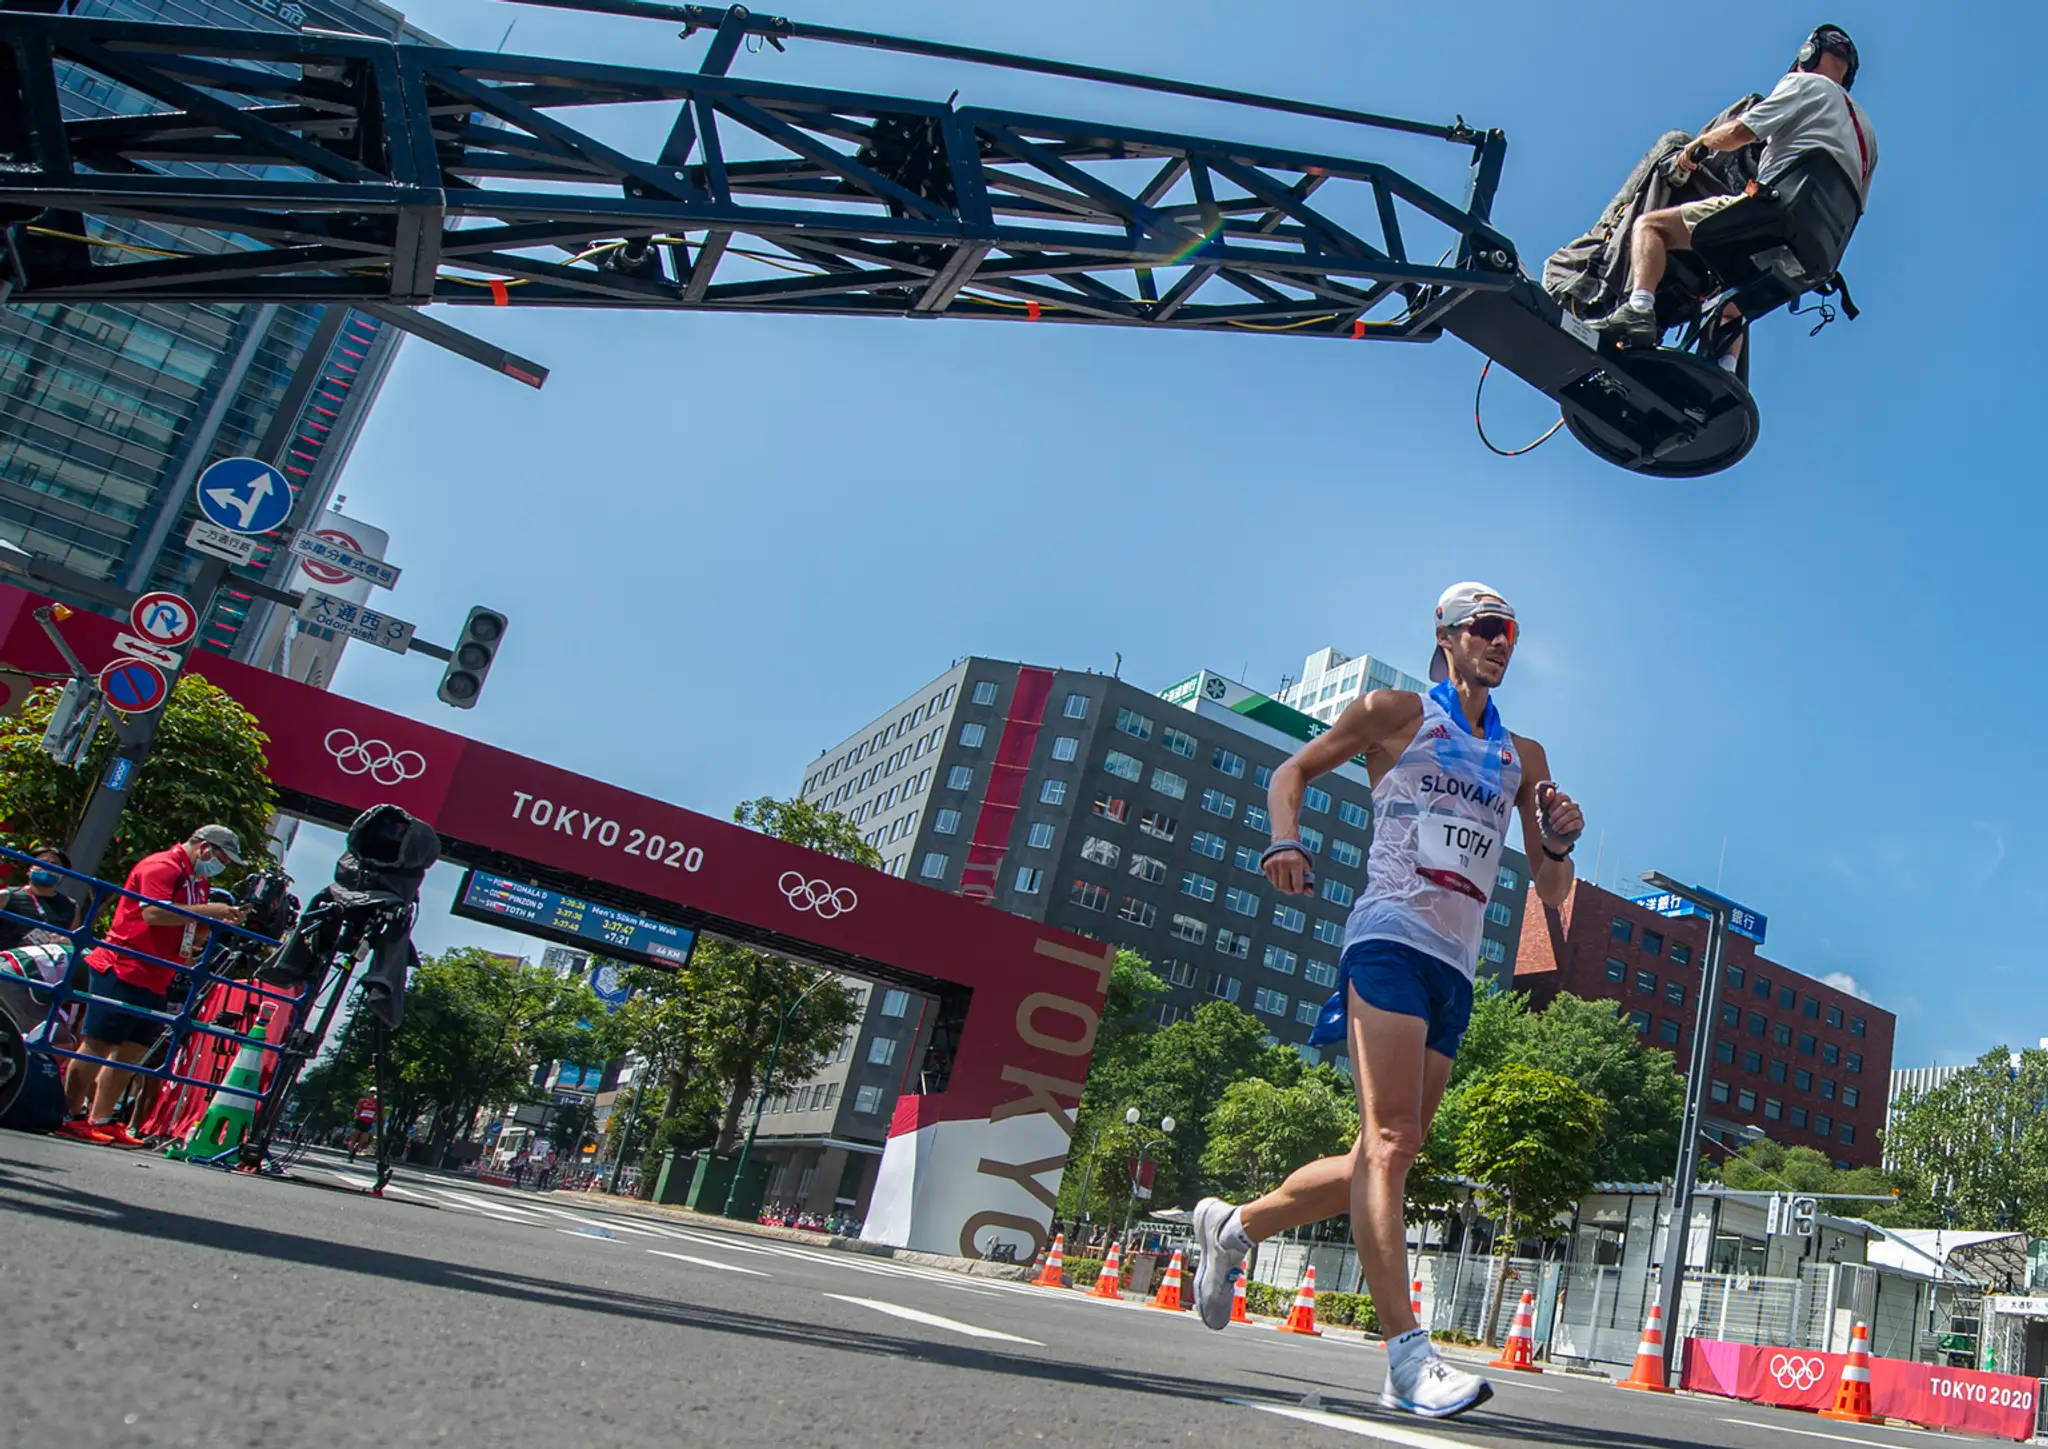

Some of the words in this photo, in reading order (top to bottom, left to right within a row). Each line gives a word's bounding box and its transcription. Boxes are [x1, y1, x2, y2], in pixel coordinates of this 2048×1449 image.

[299, 538, 394, 583] 歩車分離式信号
[311, 593, 383, 631] 大通西
[387, 621, 405, 640] 3
[1420, 774, 1506, 819] SLOVAKIA
[511, 790, 620, 848] TOKYO
[624, 828, 704, 873] 2020
[1443, 824, 1493, 859] TOTH
[508, 894, 537, 908] PINZON
[537, 902, 544, 910] D
[512, 884, 540, 897] TOMALA
[505, 905, 526, 916] TOTH
[527, 911, 535, 919] M
[592, 906, 615, 919] Men's
[616, 913, 638, 925] 50km
[639, 919, 657, 931] Race
[658, 925, 678, 936] Walk
[602, 919, 635, 935] 3:37:47
[604, 932, 630, 945] +7:21
[959, 936, 1118, 1268] TOKYO
[1930, 1378, 1987, 1403] TOKYO
[1989, 1386, 2032, 1410] 2020
